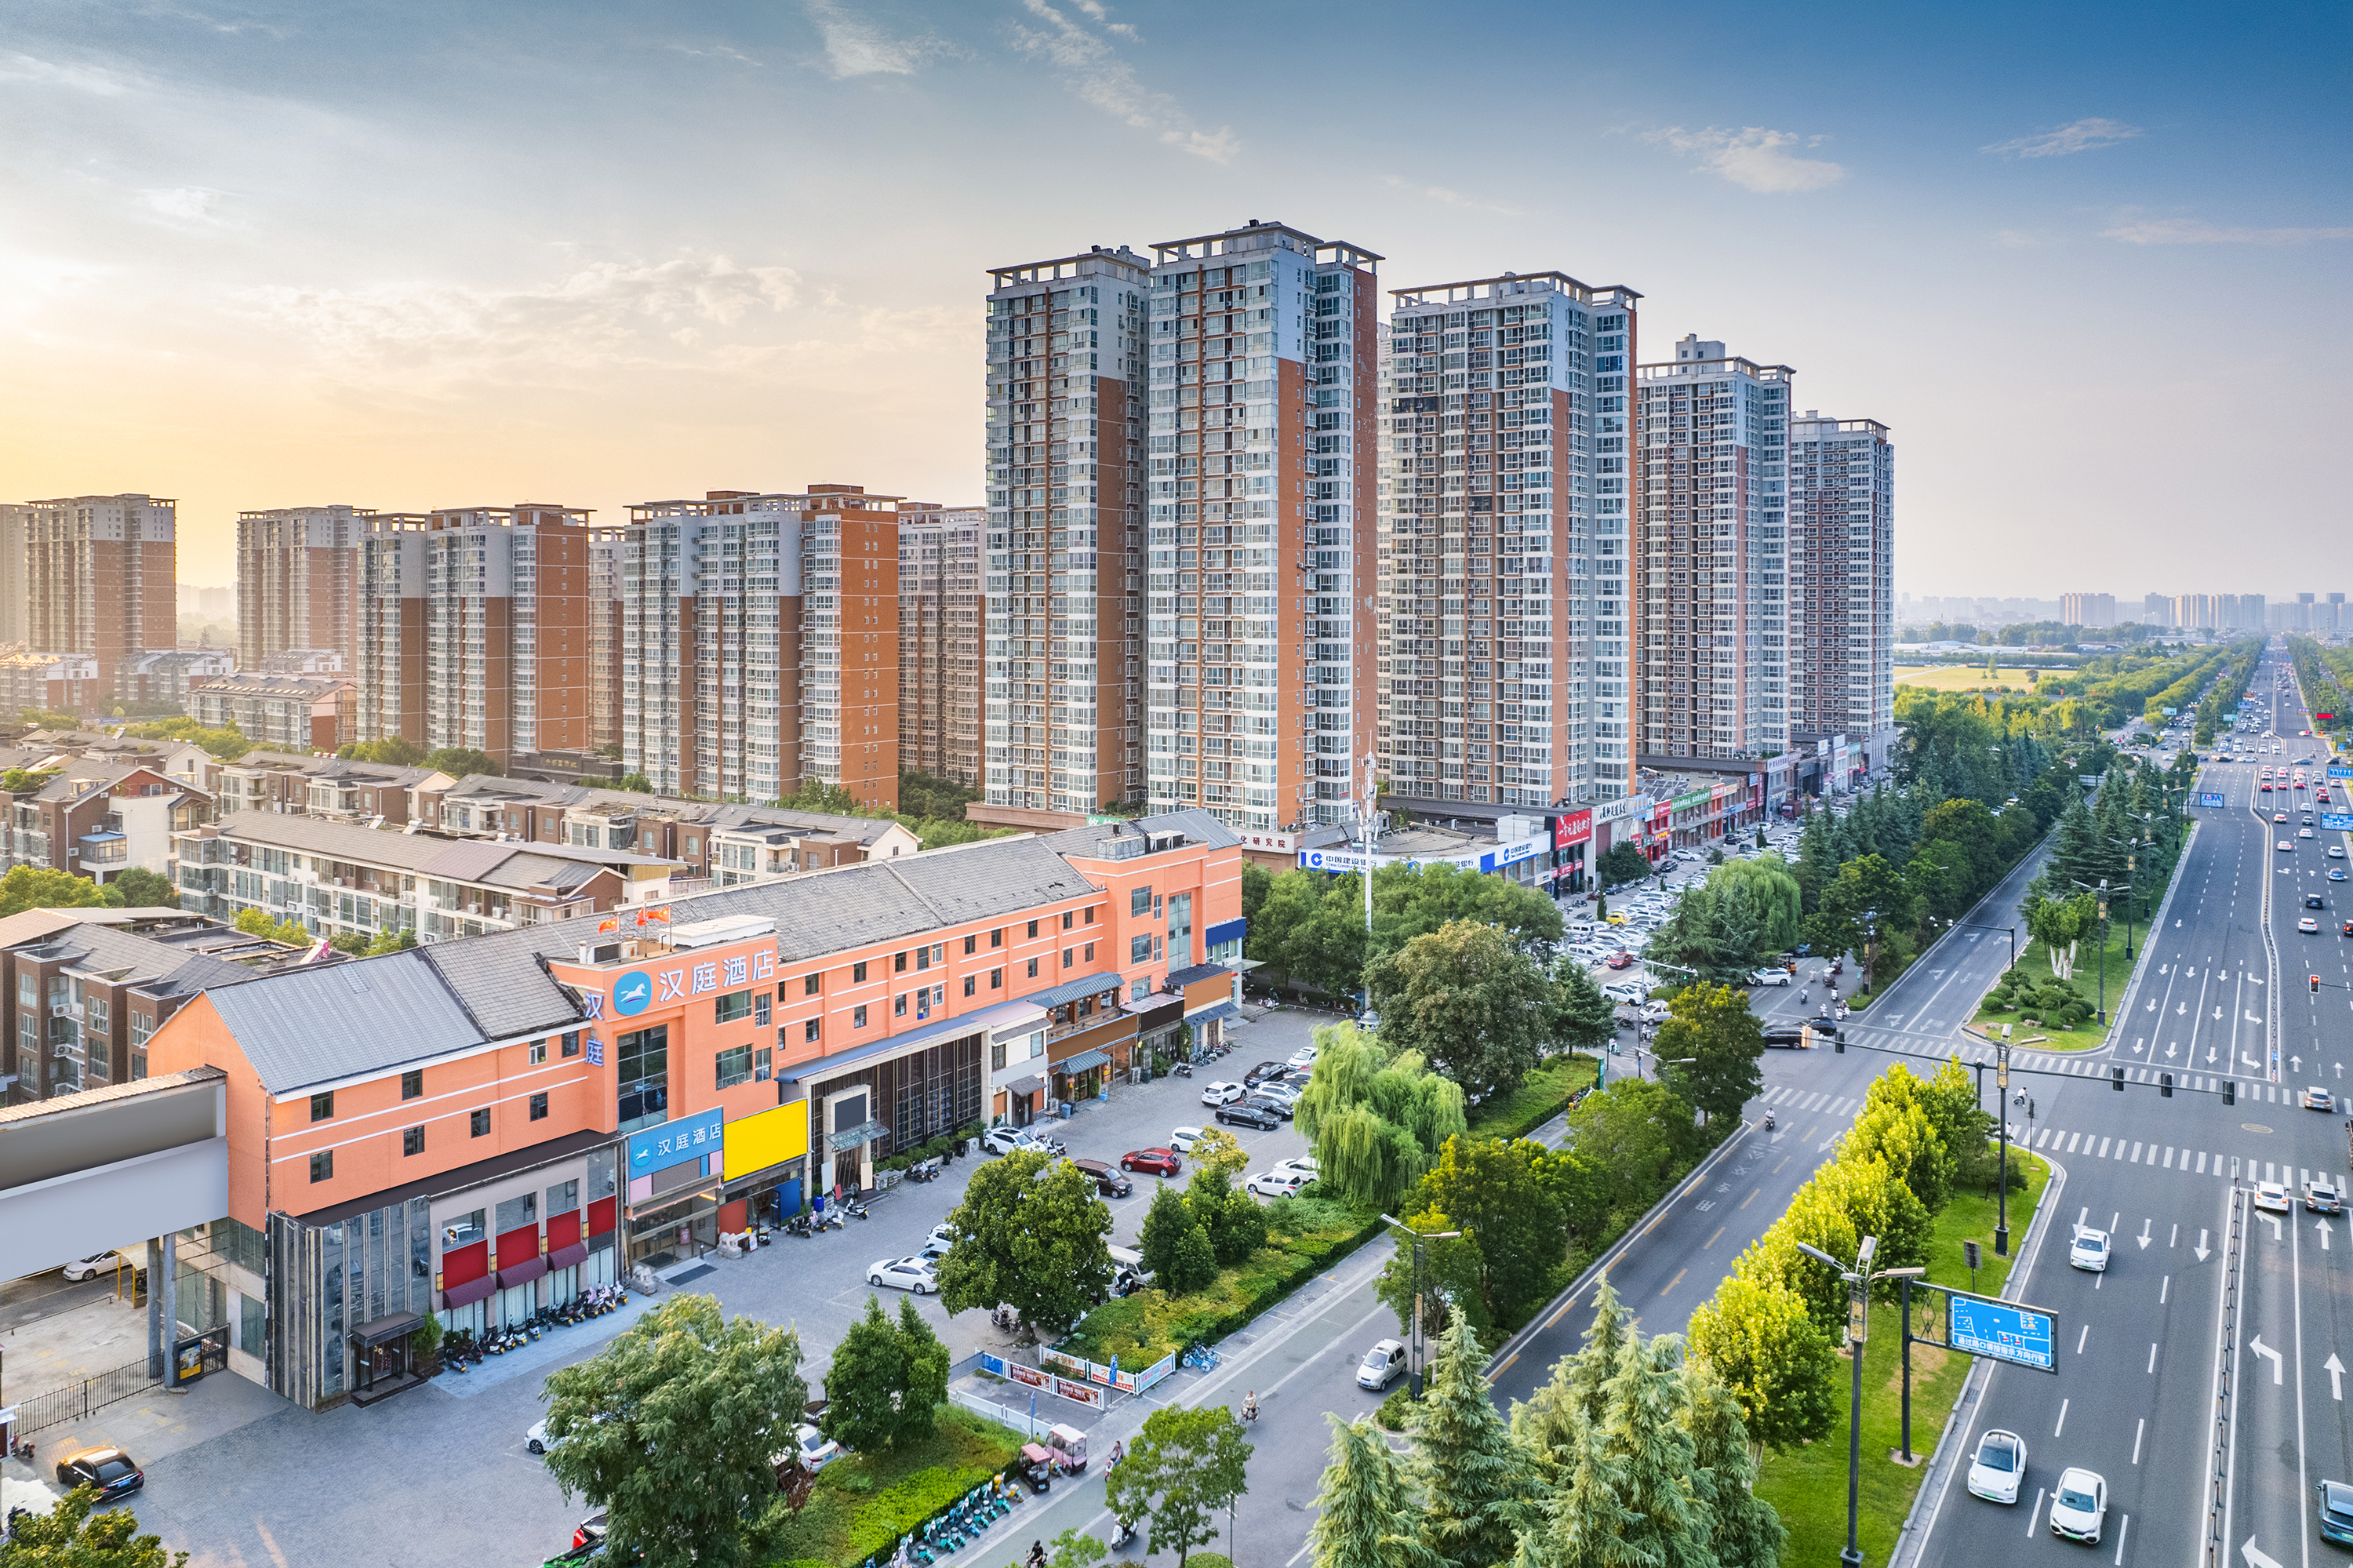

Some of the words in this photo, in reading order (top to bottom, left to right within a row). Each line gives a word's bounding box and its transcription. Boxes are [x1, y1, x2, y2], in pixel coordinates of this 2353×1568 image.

[1240, 835, 1286, 848] 化研究院
[659, 949, 774, 1002] 汉庭酒店
[584, 991, 605, 1068] 汉庭
[657, 1122, 722, 1157] 汉庭酒店
